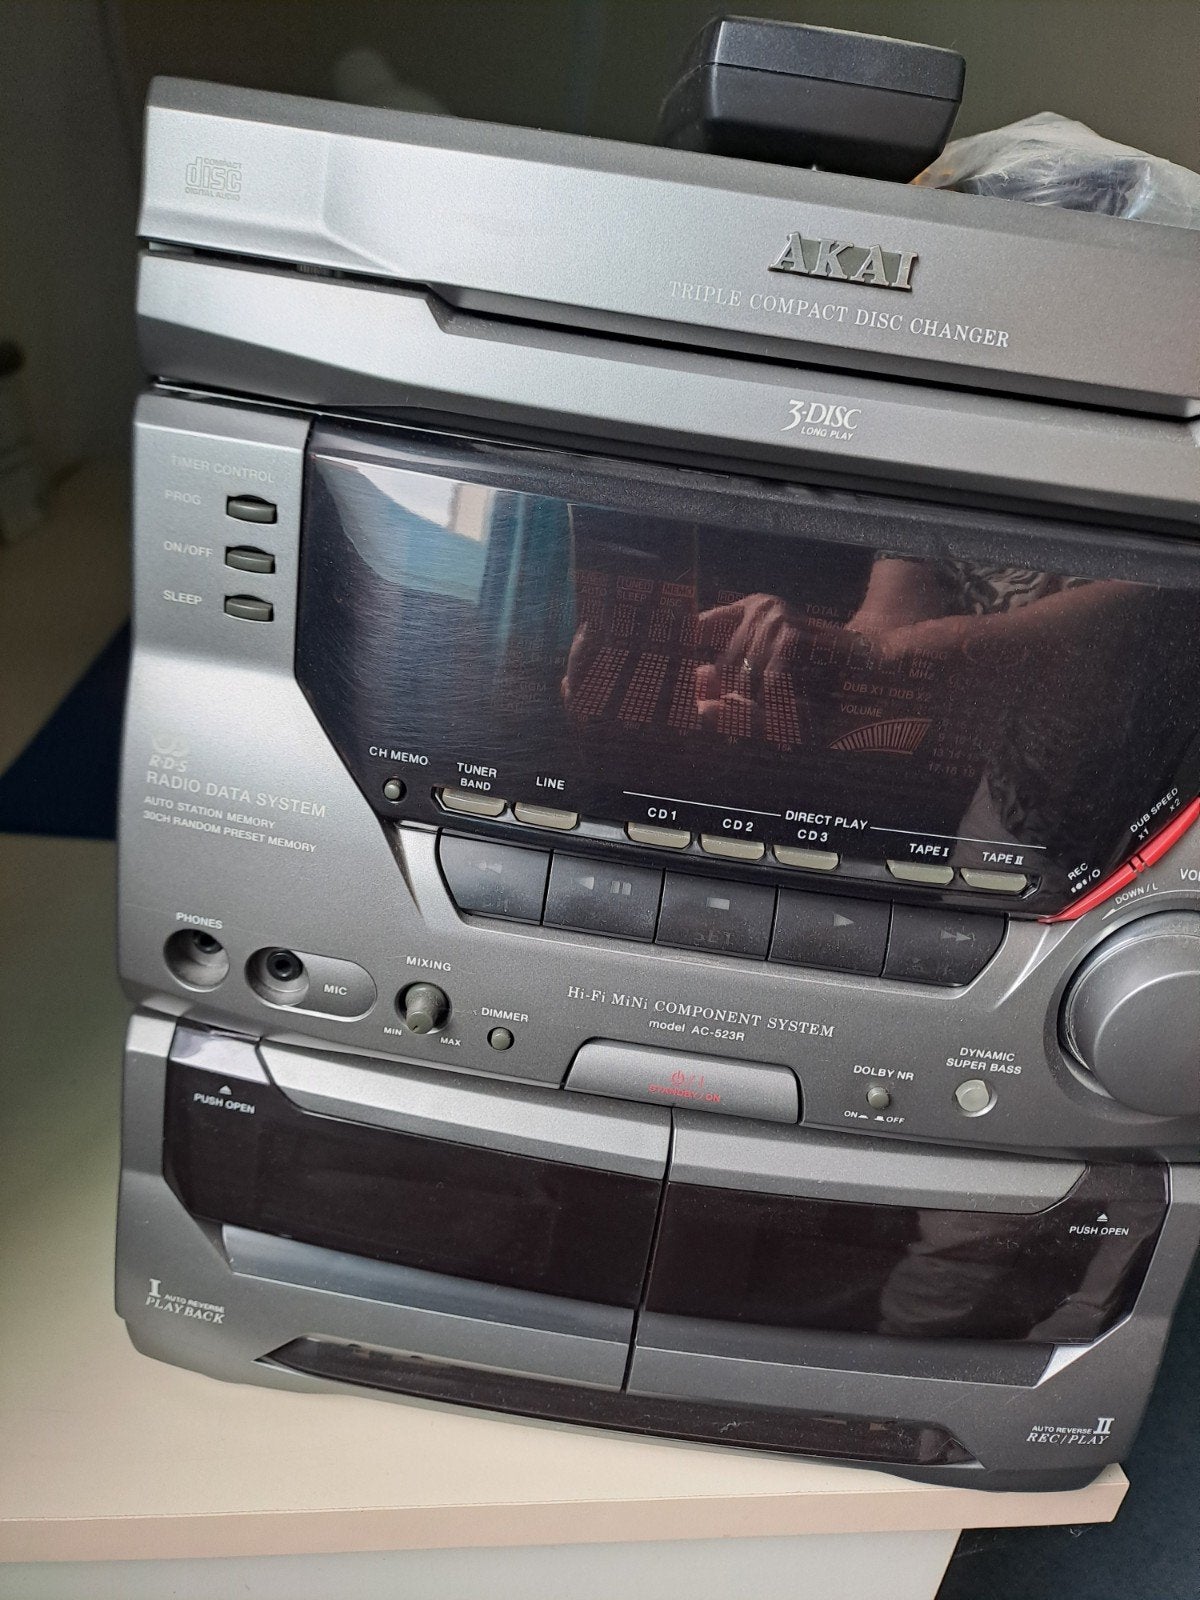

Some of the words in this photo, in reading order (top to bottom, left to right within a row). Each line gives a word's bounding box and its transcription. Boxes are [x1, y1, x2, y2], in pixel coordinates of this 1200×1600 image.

[768, 231, 919, 292] AKAI
[669, 281, 742, 306] TRIPLE
[750, 294, 848, 323] COMPACT
[854, 309, 903, 331] DISC
[909, 318, 1010, 348] CHANGER
[801, 426, 829, 438] LONG
[830, 429, 854, 441] PLAY
[172, 456, 210, 470] TIMER
[213, 463, 275, 483] CONTROL
[164, 489, 203, 505] PROG
[163, 540, 213, 558] ON/OFF
[163, 590, 202, 605] SLEEP
[840, 703, 884, 718] VOLUME
[369, 746, 387, 758] CH
[390, 750, 428, 766] MEMO
[457, 762, 498, 779] TUNER
[460, 778, 491, 791] BAND
[536, 776, 565, 791] LINE
[147, 771, 201, 793] RADIO
[206, 782, 251, 803] DATA
[256, 793, 326, 818] SYSTEM
[144, 796, 174, 809] AUTO
[177, 802, 223, 819] STATION
[227, 812, 276, 829] MEMORY
[1129, 813, 1151, 833] DUB
[1150, 787, 1178, 815] SPEED
[785, 810, 832, 826] DIRECT
[834, 816, 868, 831] PLAY
[143, 810, 171, 823] 30CH
[173, 816, 221, 834] RANDOM
[223, 826, 265, 843] PRESET
[268, 836, 317, 853] MEMORY
[909, 843, 941, 856] TAPE
[982, 851, 1014, 864] TAPE
[1067, 862, 1089, 881] REC
[1180, 868, 1200, 881] VO
[1115, 886, 1145, 905] DOWN
[176, 912, 223, 929] PHONES
[406, 956, 451, 972] MIXING
[323, 983, 347, 995] MIC
[481, 1007, 529, 1023] DIMMER
[568, 986, 606, 1003] Hi-Fi
[611, 993, 648, 1010] MiNi
[654, 1000, 761, 1027] COMPONENT
[767, 1017, 835, 1038] SYSTEM
[383, 1026, 402, 1036] MIN
[649, 1020, 686, 1033] model
[691, 1025, 745, 1042] AC-523R
[440, 1036, 461, 1046] MAX
[959, 1047, 1015, 1062] DYNAMIC
[853, 1065, 895, 1079] DOLBY
[896, 1071, 914, 1081] NR
[946, 1058, 986, 1071] SUPER
[989, 1063, 1022, 1075] BASS
[193, 1093, 224, 1107] PUSH
[225, 1100, 256, 1114] OPEN
[844, 1110, 858, 1119] ON
[886, 1116, 905, 1124] OFF
[1069, 1225, 1098, 1235] PUSH
[1100, 1227, 1129, 1236] OPEN
[164, 1294, 186, 1305] AUTO
[187, 1299, 225, 1312] REVERSE
[1031, 1425, 1054, 1433] AUTO
[1055, 1426, 1092, 1435] REVERSE
